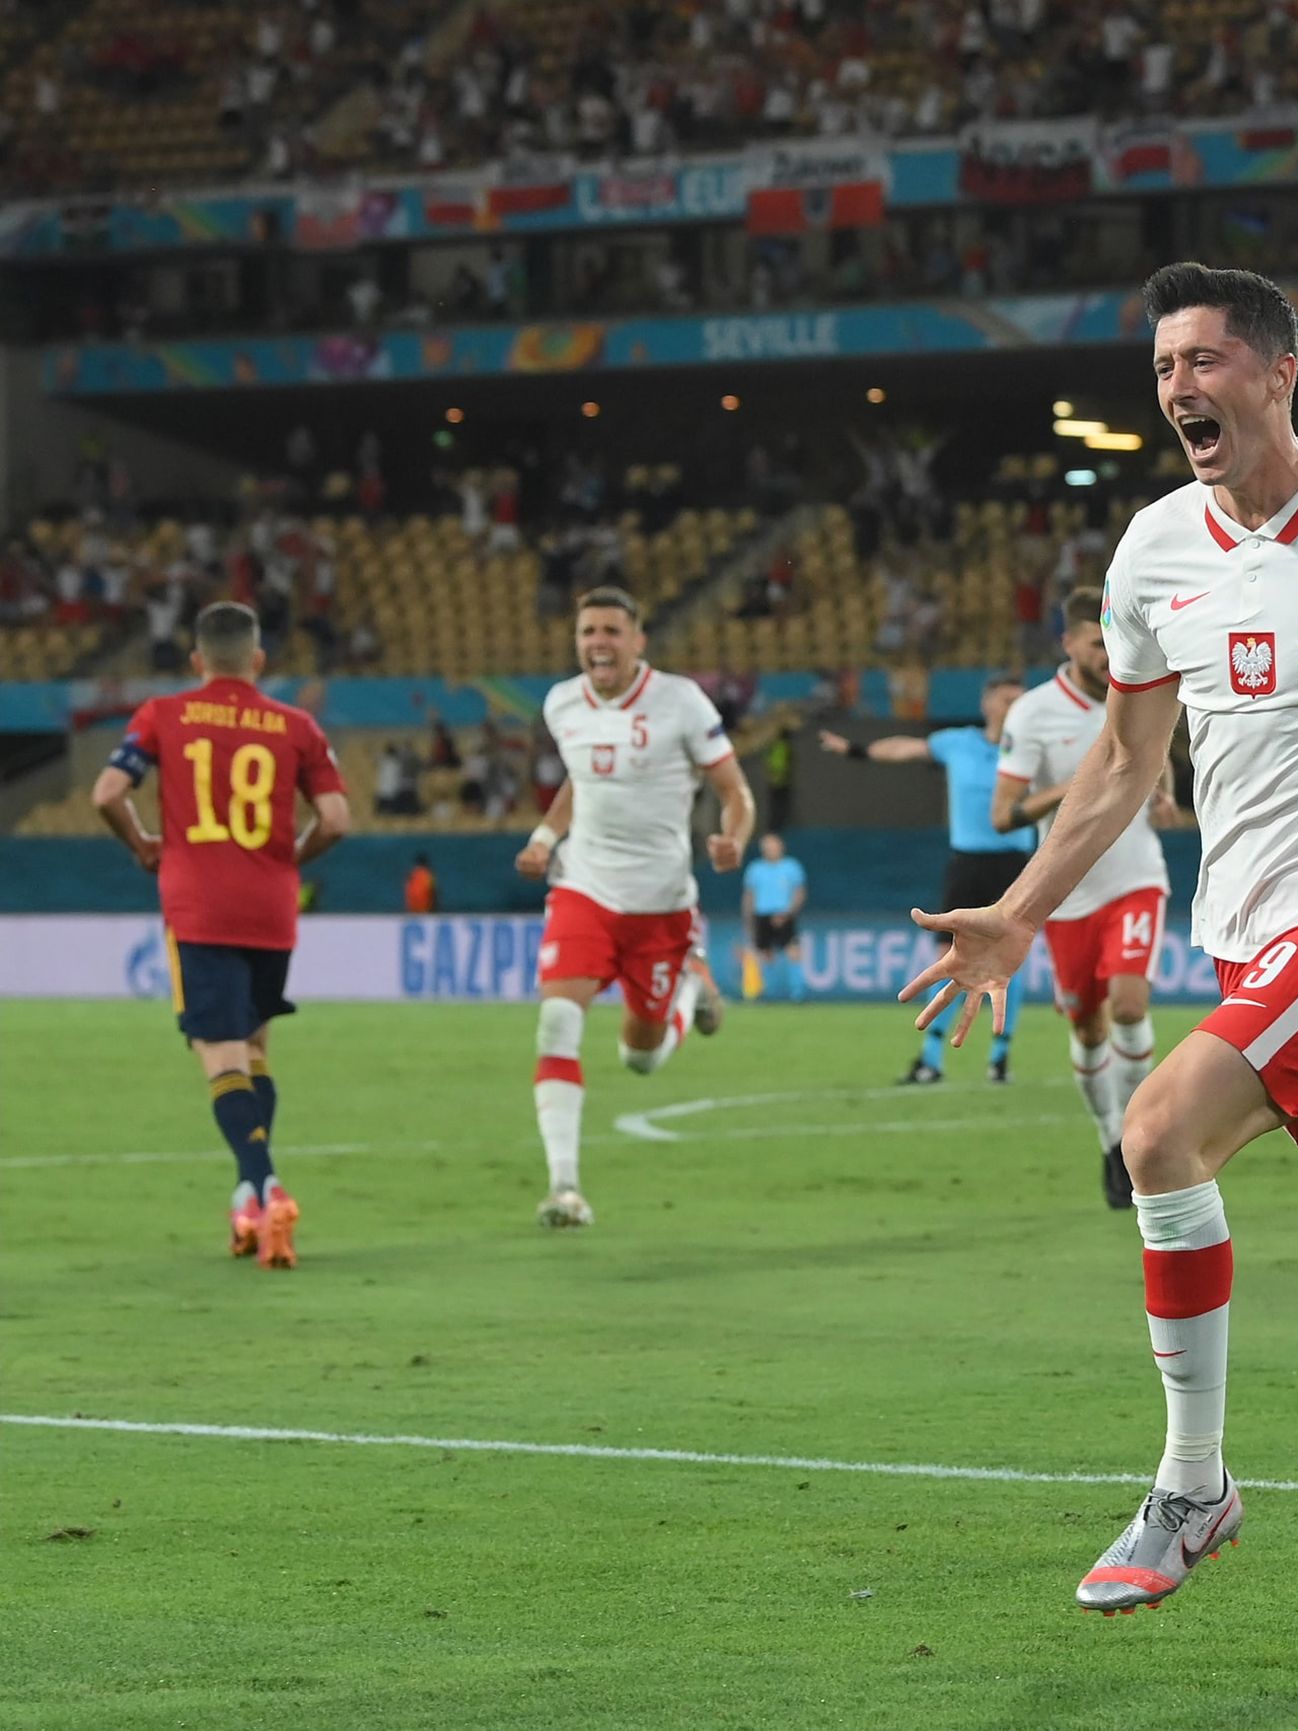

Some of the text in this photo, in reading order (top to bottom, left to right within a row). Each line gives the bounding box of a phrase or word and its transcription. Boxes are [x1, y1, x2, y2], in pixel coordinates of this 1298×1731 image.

[704, 313, 838, 358] SEVILLE
[240, 707, 287, 735] ALBA
[632, 714, 648, 750] 5
[183, 738, 277, 849] 18
[1122, 911, 1152, 947] 14
[652, 961, 669, 998] 5
[1242, 941, 1297, 989] 9
